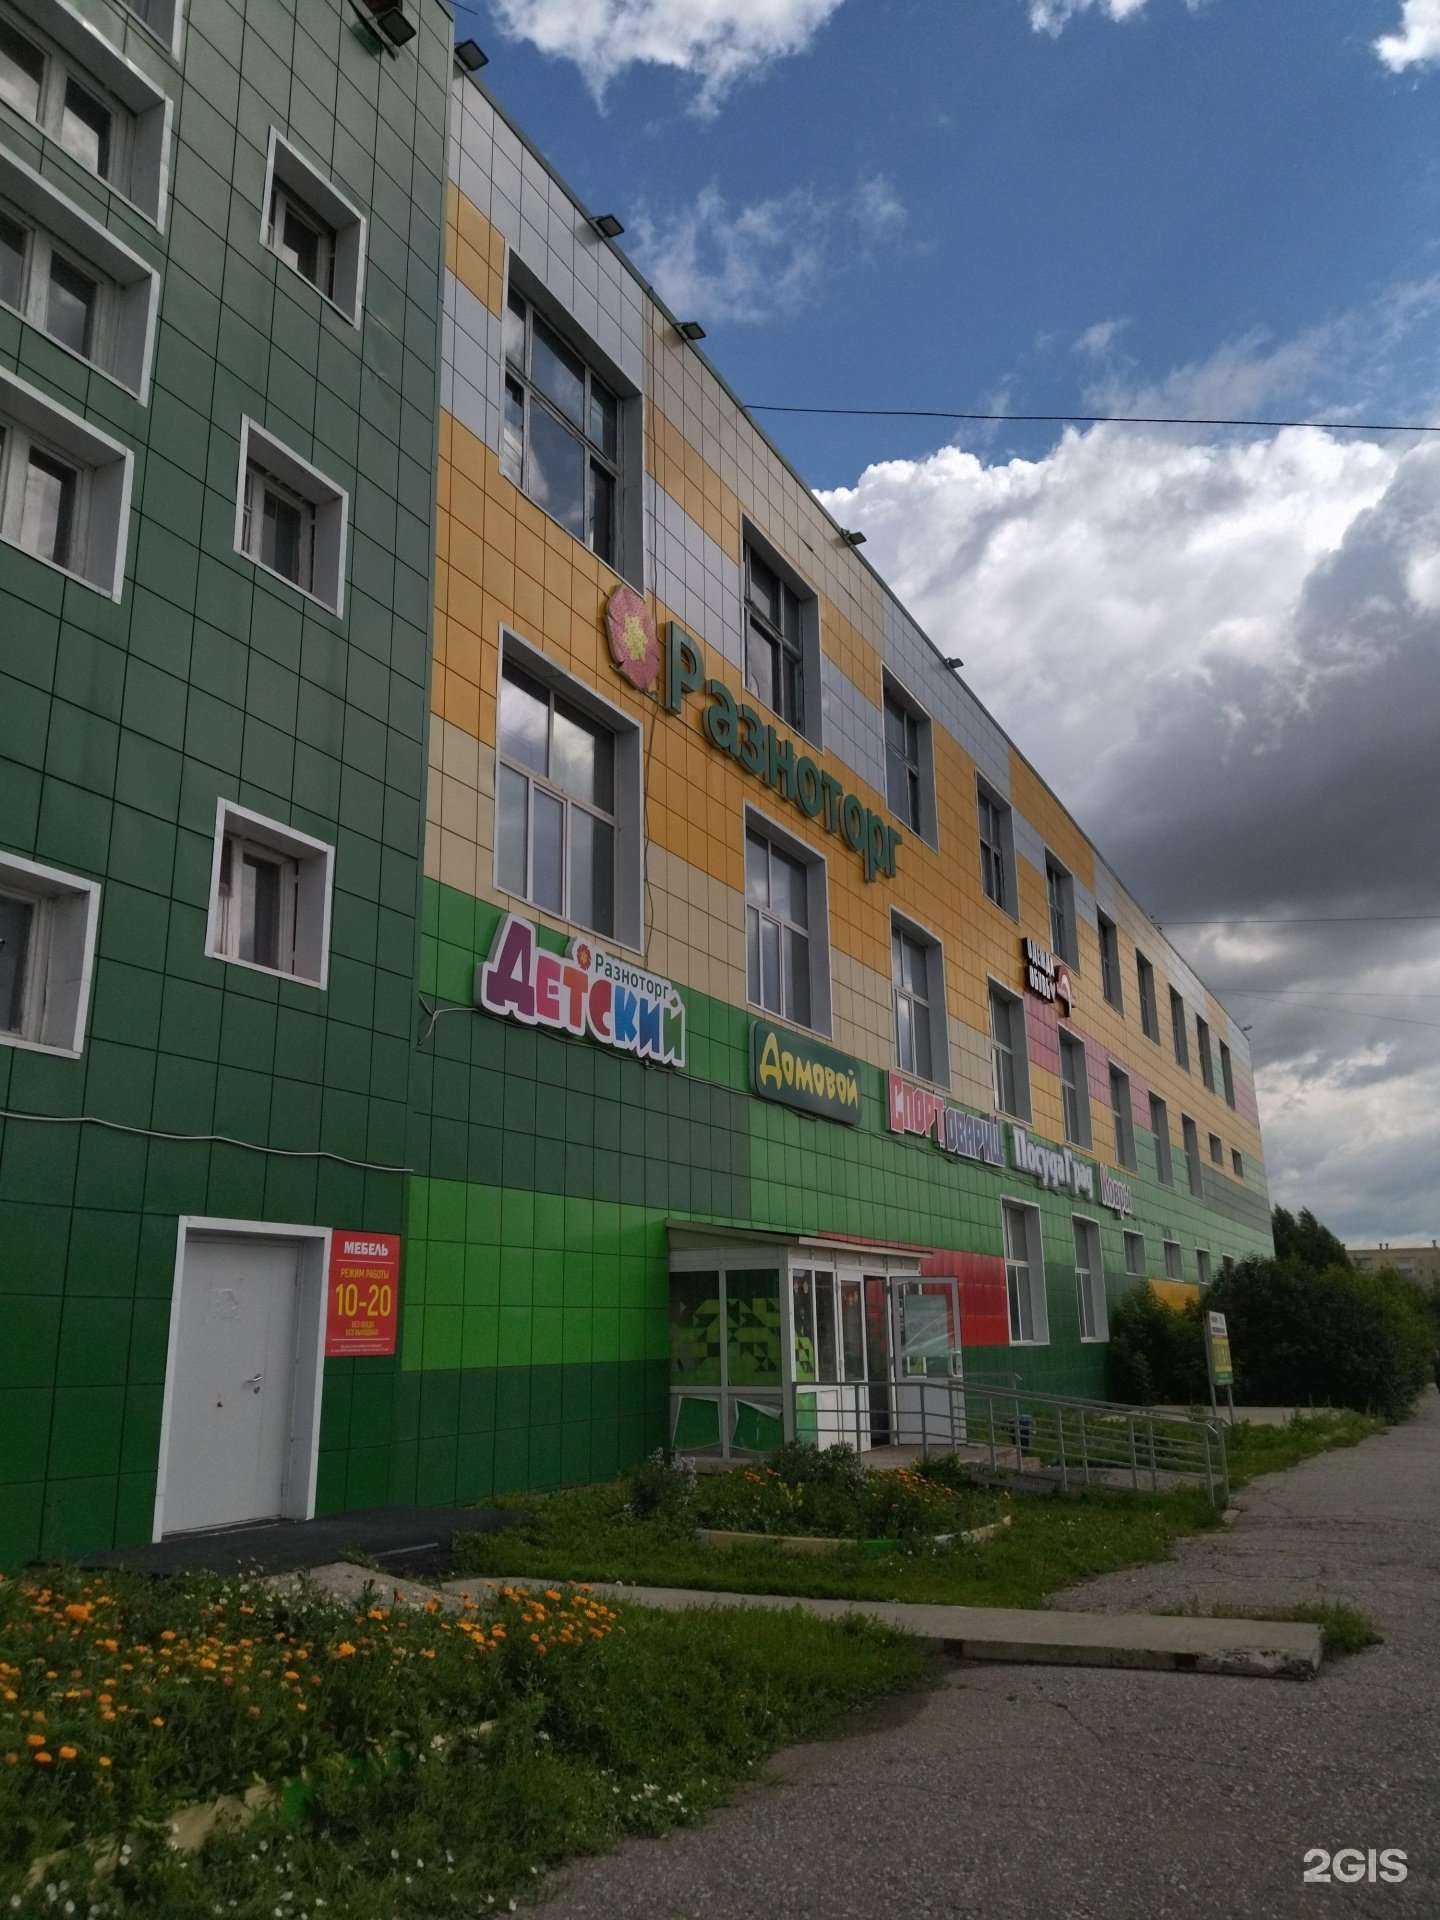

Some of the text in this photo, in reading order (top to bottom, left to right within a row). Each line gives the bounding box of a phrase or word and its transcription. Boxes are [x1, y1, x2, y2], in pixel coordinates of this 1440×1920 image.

[664, 620, 903, 884] Разноторг
[484, 919, 684, 1062] ДЕТСКИЙ
[595, 952, 669, 1000] Разноторг
[343, 1241, 389, 1256] МЕБЕЛЬ
[335, 1282, 391, 1317] 10-20
